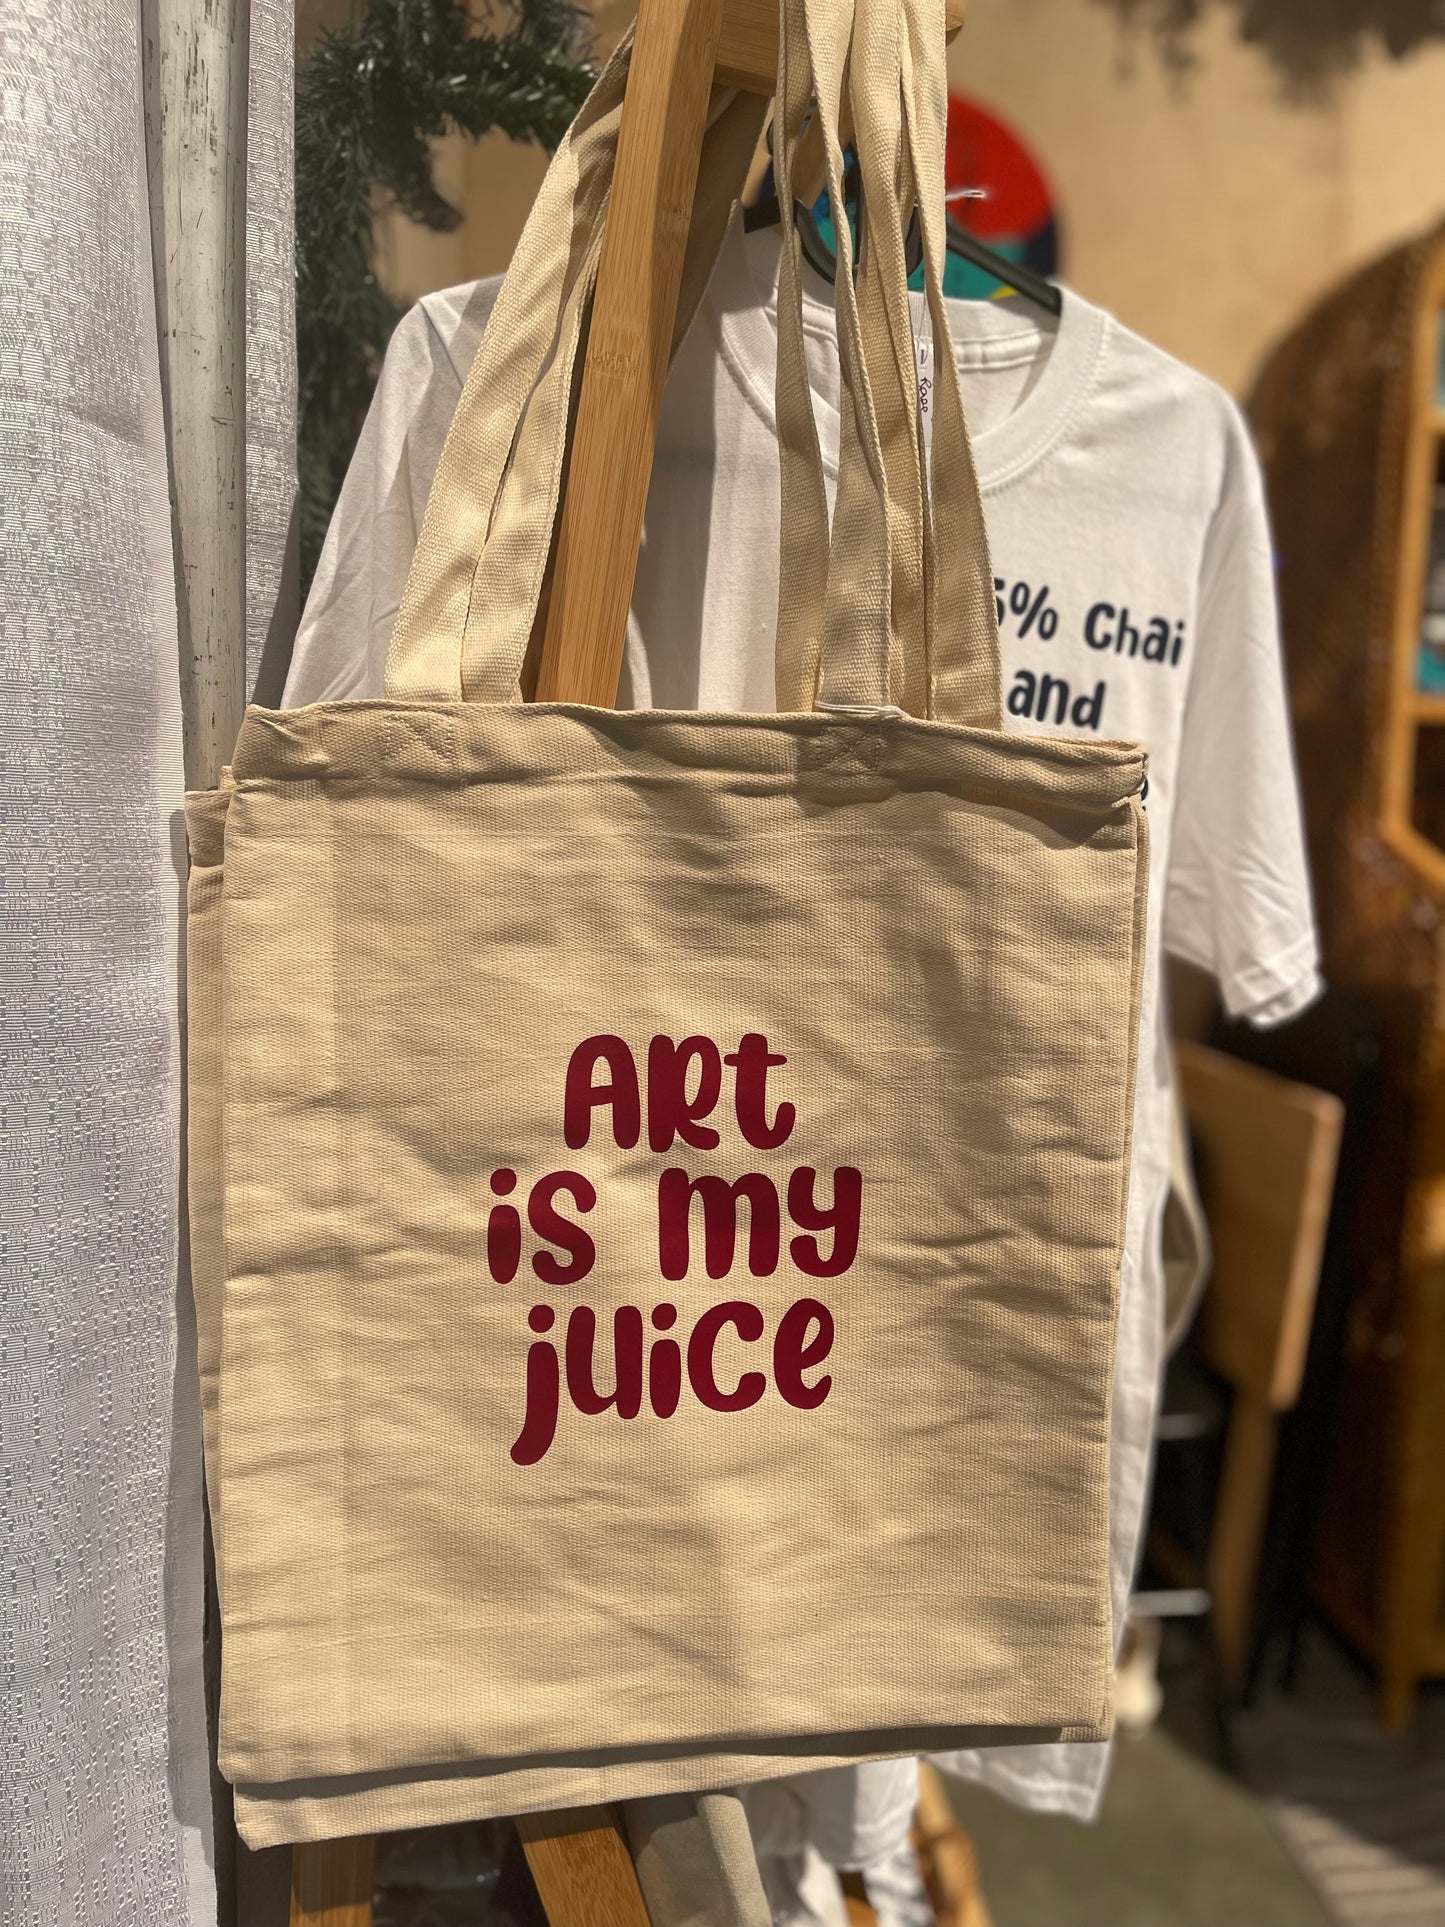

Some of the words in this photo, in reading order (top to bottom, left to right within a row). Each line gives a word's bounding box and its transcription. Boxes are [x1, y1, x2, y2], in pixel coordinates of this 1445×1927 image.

[1084, 602, 1186, 667] Chai
[1007, 669, 1106, 731] and
[487, 1168, 597, 1285] is
[658, 1166, 863, 1281] my
[510, 1298, 835, 1466] juice
